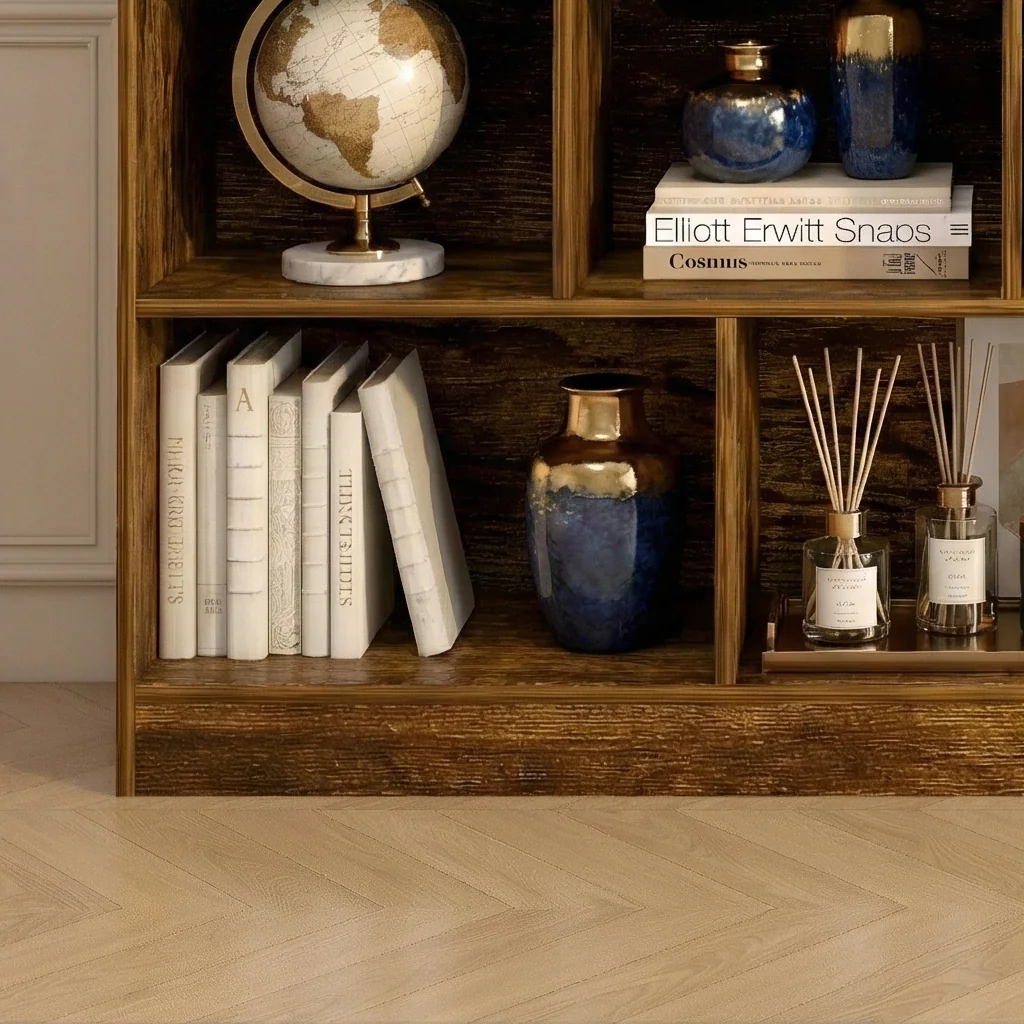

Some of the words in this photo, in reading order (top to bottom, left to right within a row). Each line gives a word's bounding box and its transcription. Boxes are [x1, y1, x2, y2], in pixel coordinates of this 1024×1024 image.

[655, 217, 731, 243] Elliott
[743, 217, 825, 243] Erwitt
[235, 387, 254, 412] A
